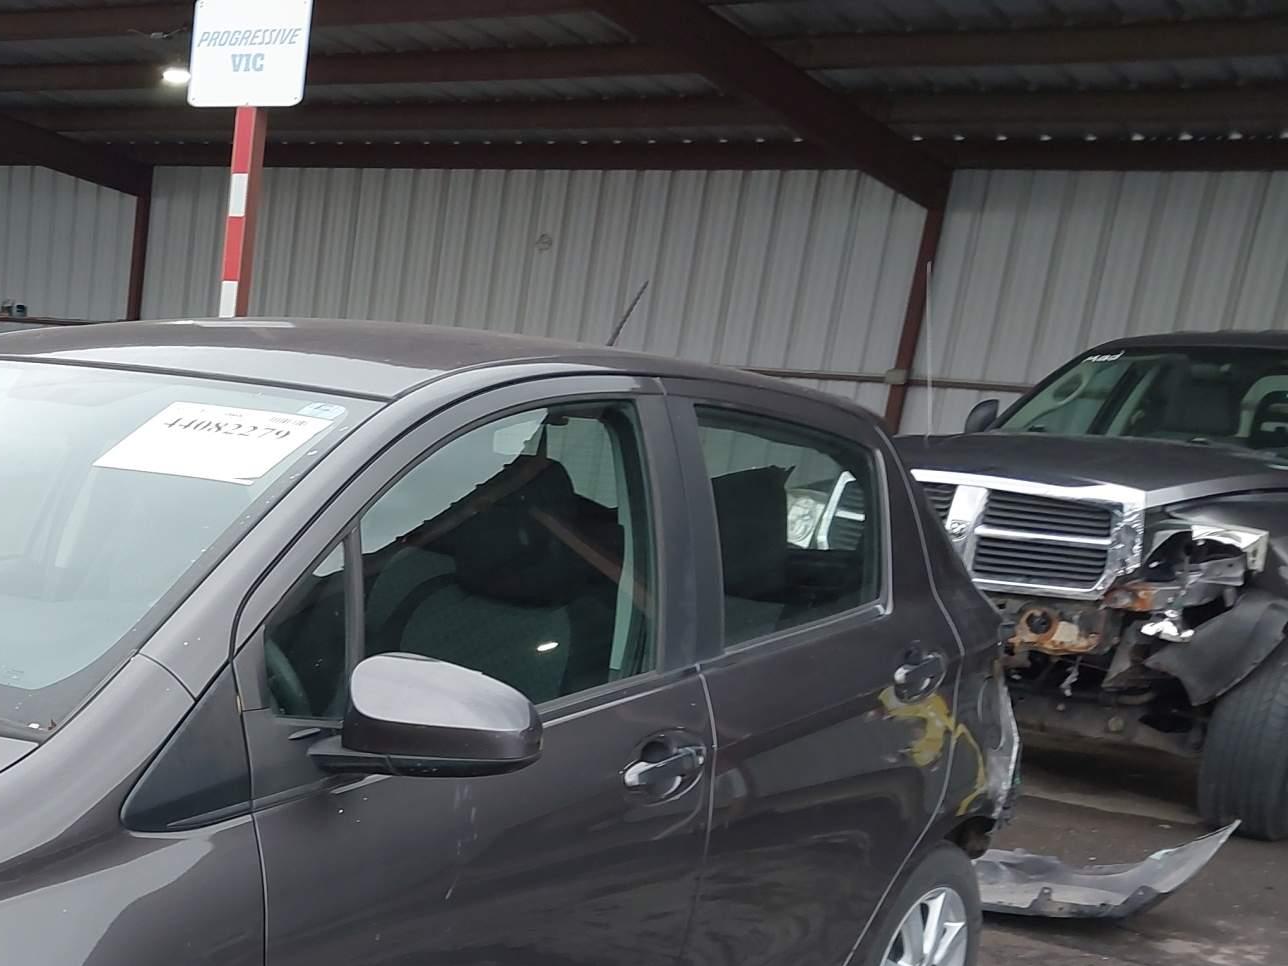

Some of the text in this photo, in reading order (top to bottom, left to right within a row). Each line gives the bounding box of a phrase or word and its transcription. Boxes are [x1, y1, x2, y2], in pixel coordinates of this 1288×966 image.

[197, 28, 302, 47] PROGRESSIVE
[231, 53, 265, 72] VIC
[164, 417, 291, 439] 44082279
